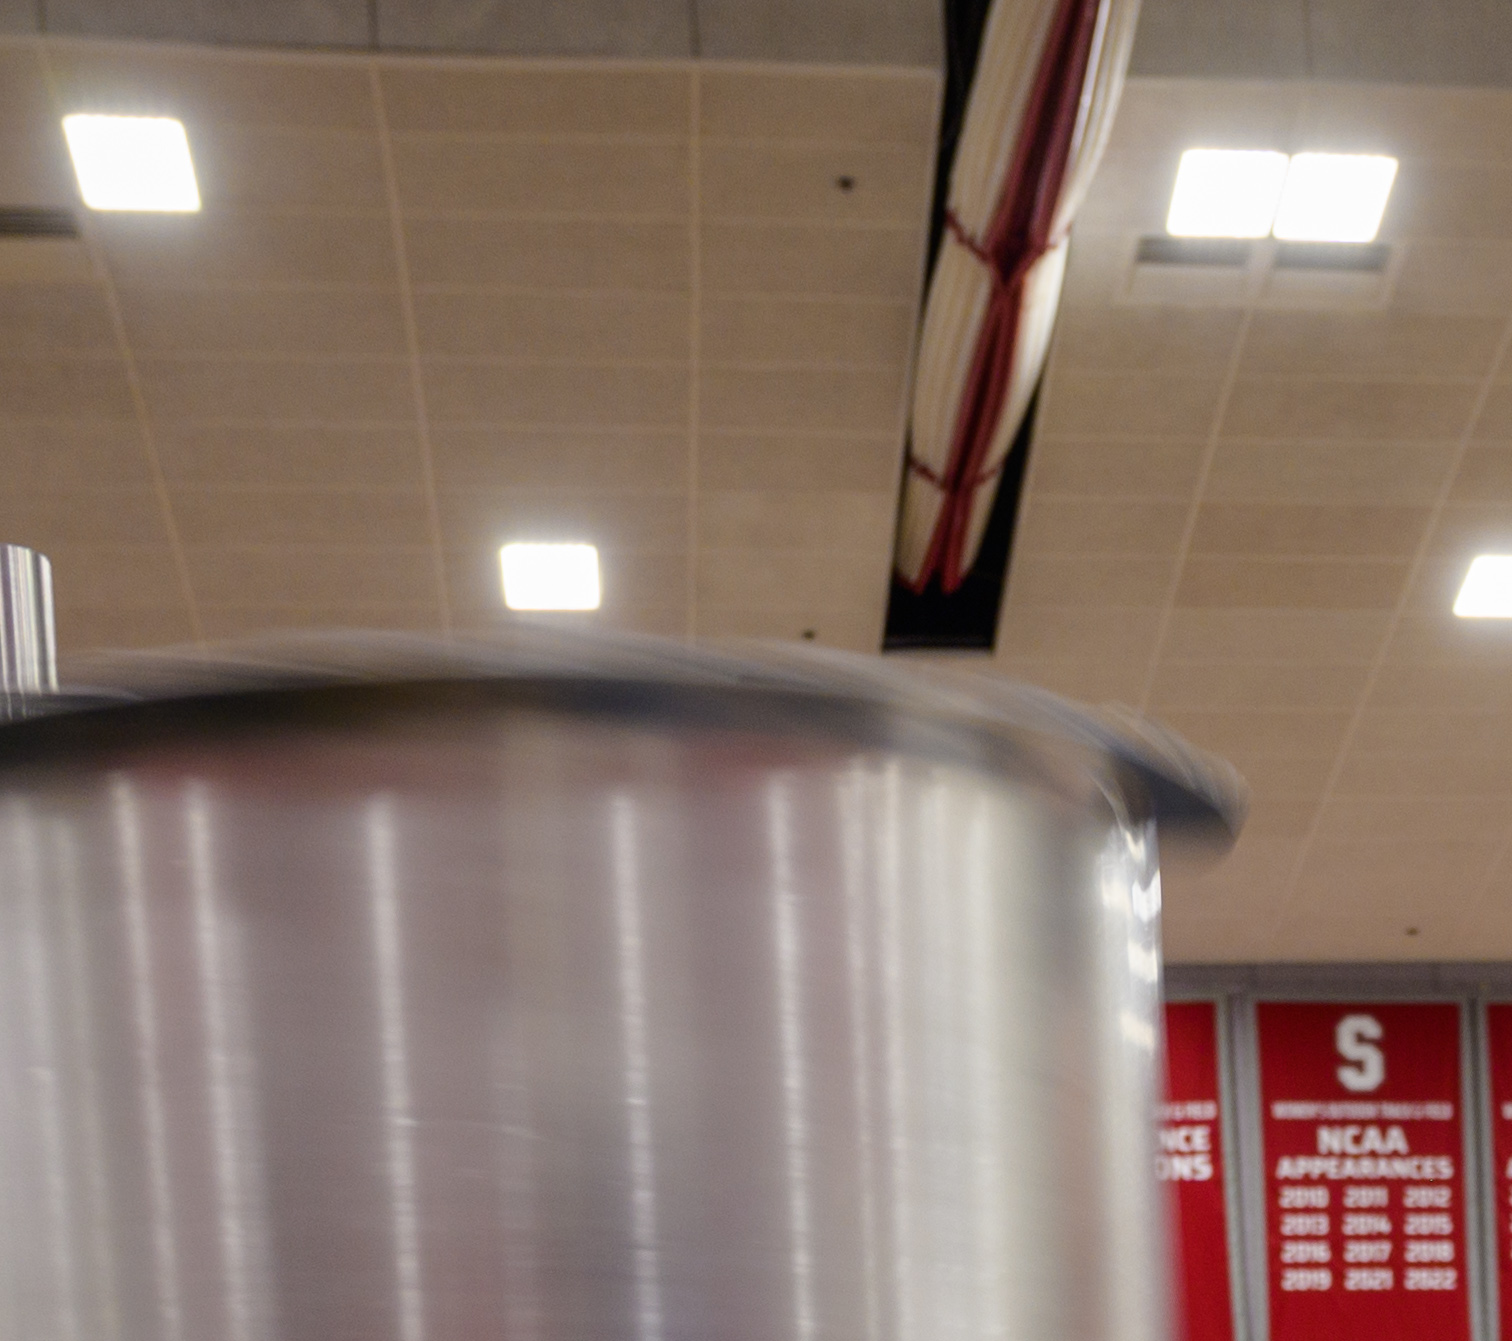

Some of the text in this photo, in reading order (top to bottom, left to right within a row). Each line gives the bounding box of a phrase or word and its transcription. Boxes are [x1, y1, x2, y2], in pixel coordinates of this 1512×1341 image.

[1334, 1014, 1385, 1093] S
[1316, 1124, 1409, 1156] NCAA
[1275, 1155, 1454, 1180] APPEARANCES
[1403, 1185, 1452, 1209] 2012
[1342, 1213, 1392, 1236] 2014
[1343, 1240, 1392, 1264] 2017
[1404, 1267, 1458, 1291] 2022
